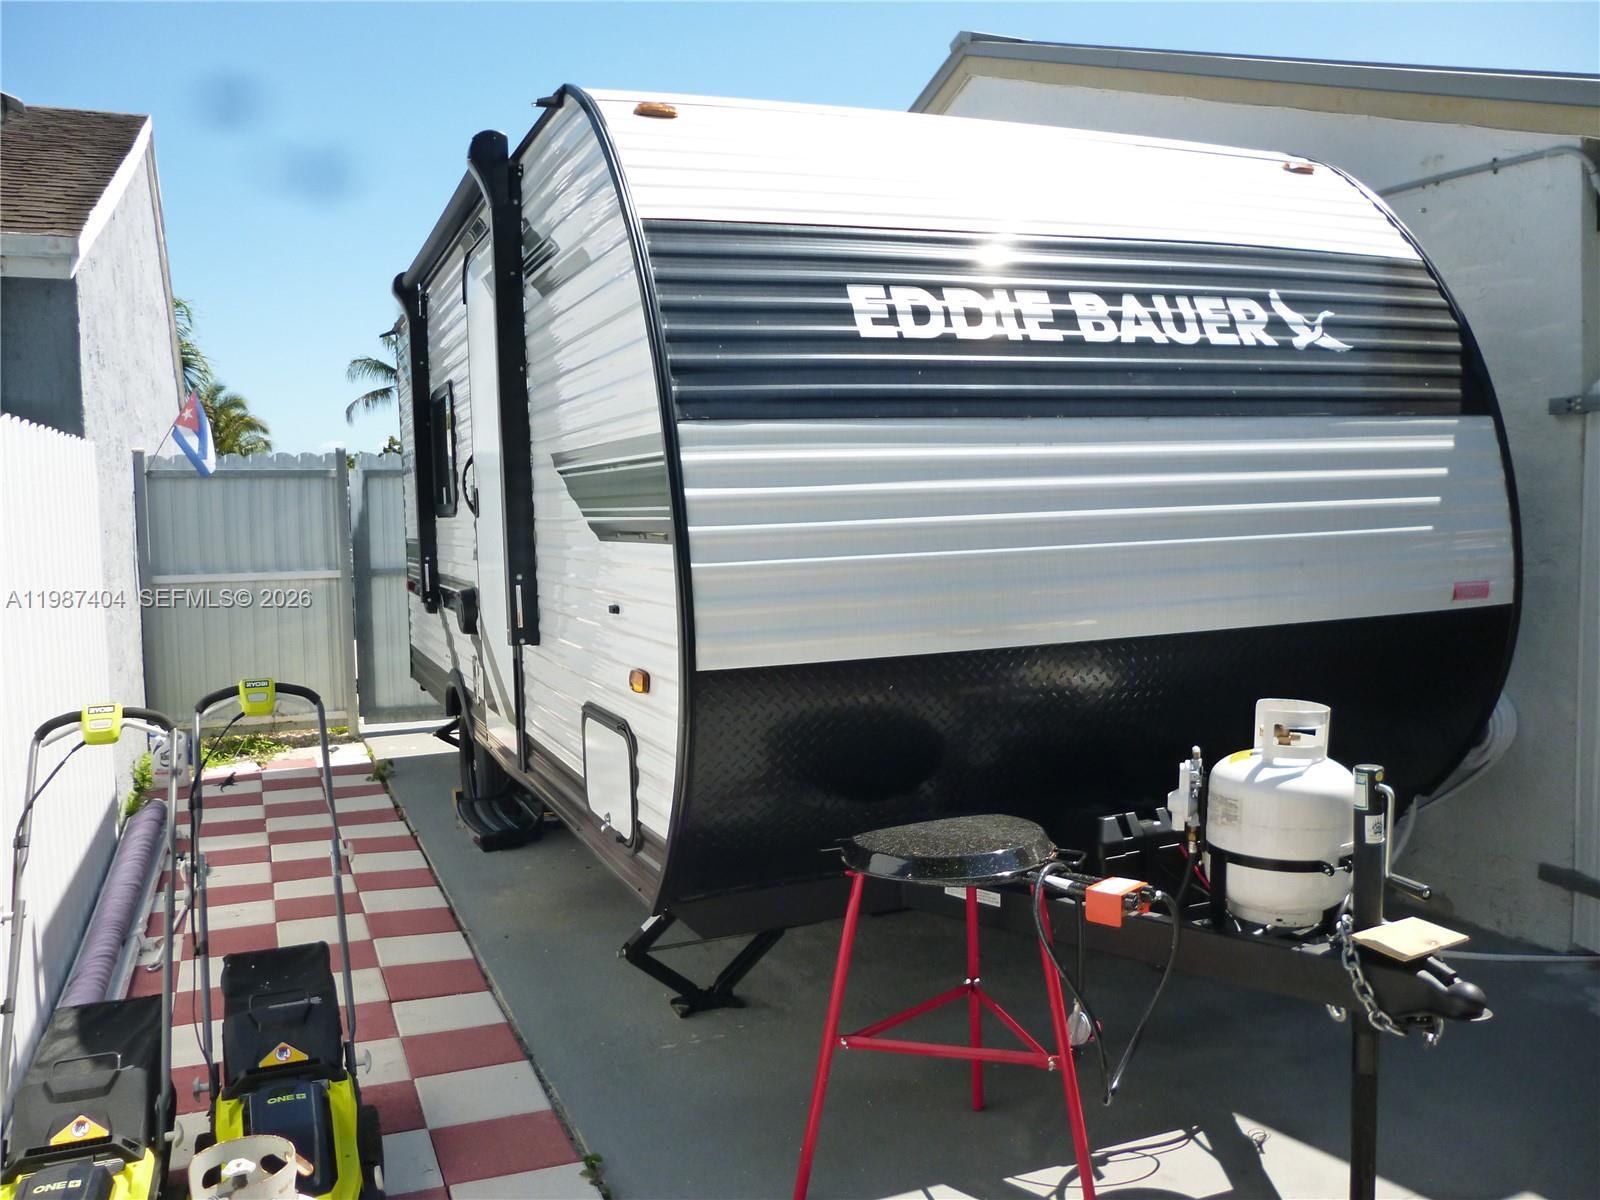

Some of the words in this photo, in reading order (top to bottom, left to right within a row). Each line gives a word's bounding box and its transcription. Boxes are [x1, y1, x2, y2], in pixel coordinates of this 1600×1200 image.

[846, 283, 1065, 342] EDDIE
[1067, 291, 1280, 347] BAUER
[88, 706, 115, 714] RYOBI
